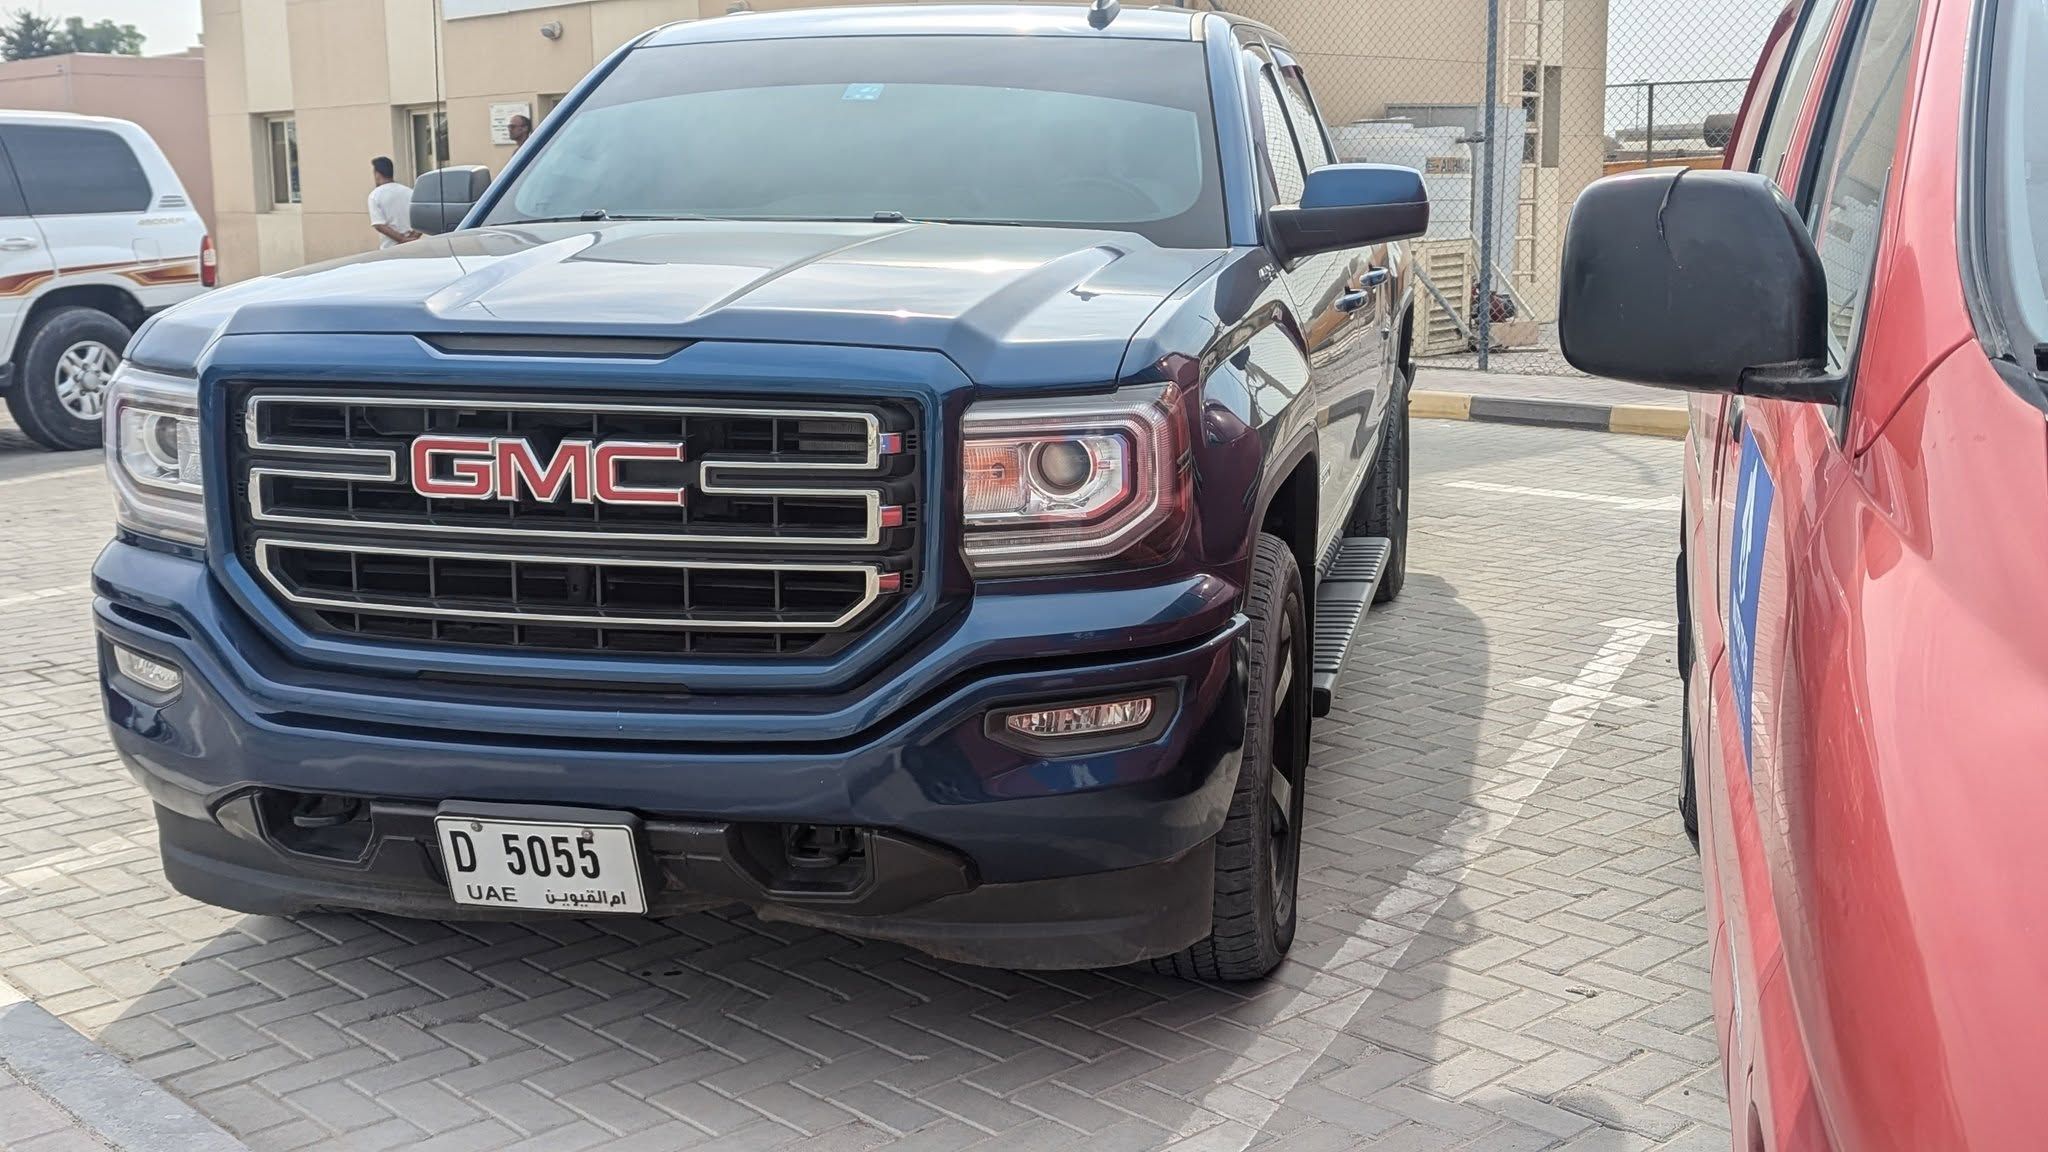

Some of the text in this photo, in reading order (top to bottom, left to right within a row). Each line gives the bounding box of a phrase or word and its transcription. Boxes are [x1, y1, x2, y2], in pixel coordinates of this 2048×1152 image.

[411, 435, 685, 507] GMC
[449, 830, 601, 879] D 5055
[466, 884, 518, 903] UAE
[545, 889, 608, 907] القيوين
